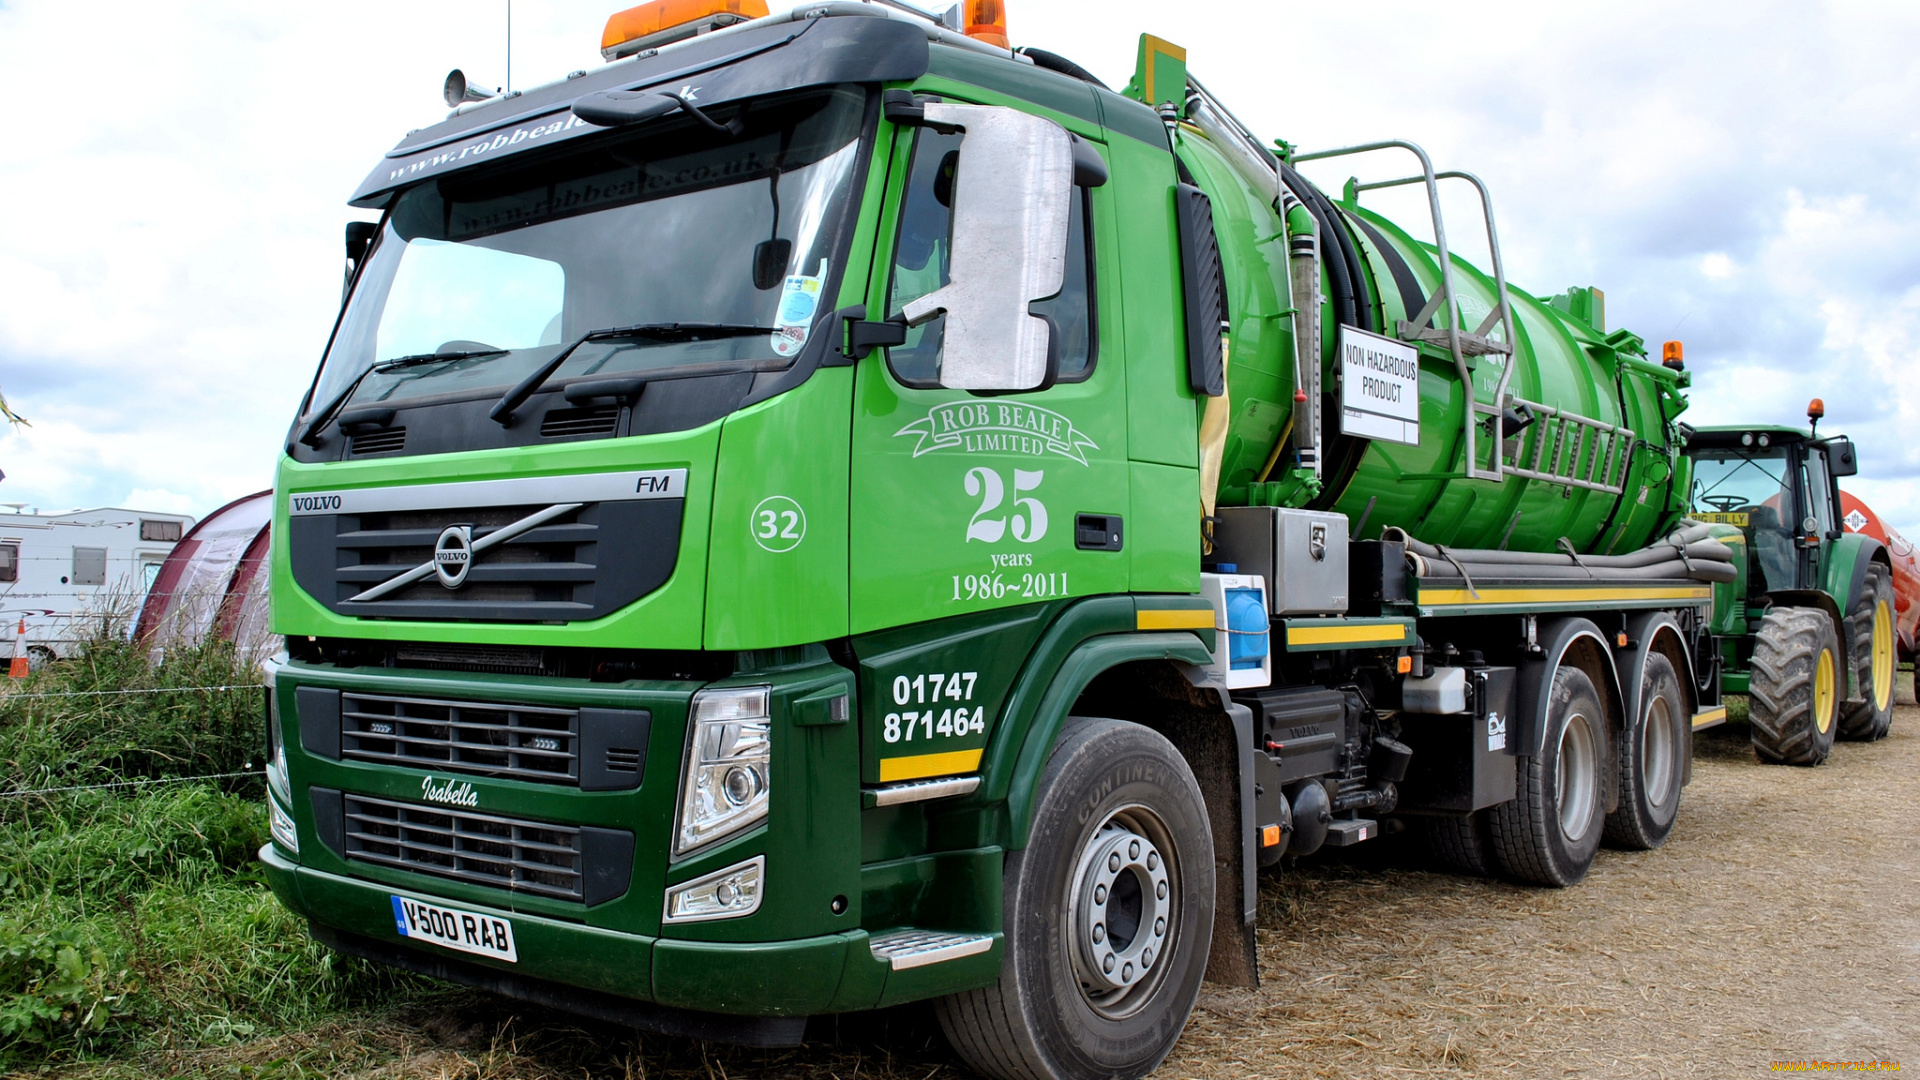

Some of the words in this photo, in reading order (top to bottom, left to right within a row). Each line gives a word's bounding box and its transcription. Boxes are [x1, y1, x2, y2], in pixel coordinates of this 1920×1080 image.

[1346, 343, 1365, 367] NON
[1367, 350, 1416, 381] HAZARDOUS
[1363, 375, 1402, 403] PRODUCT
[940, 404, 990, 432] ROB
[998, 405, 1062, 440] BEALE
[965, 434, 1043, 456] LIMITED
[636, 475, 670, 493] FM
[293, 495, 342, 511] VOLVO
[964, 466, 1048, 543] 25
[758, 510, 799, 539] 32
[1715, 514, 1745, 525] BILLY
[436, 552, 469, 561] VOLVO
[990, 553, 1032, 574] years
[892, 672, 978, 705] 01747
[883, 706, 985, 743] 871464
[421, 775, 478, 807] Isabella
[1078, 763, 1191, 826] CONTINENTA
[403, 901, 459, 941] V500
[461, 914, 509, 952] RAB
